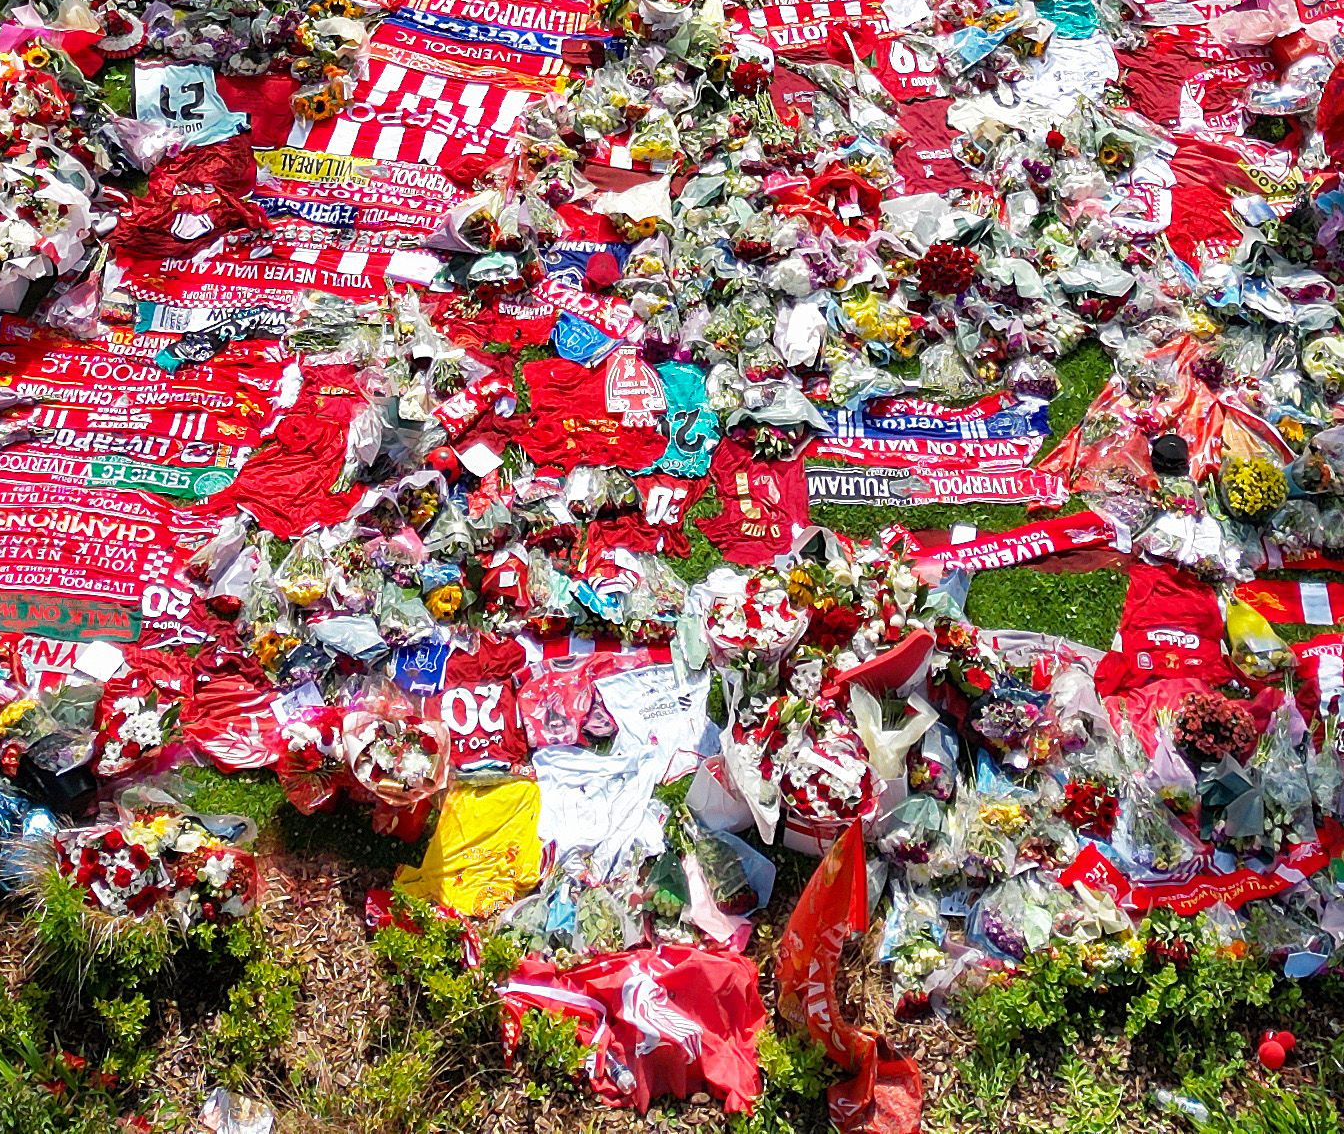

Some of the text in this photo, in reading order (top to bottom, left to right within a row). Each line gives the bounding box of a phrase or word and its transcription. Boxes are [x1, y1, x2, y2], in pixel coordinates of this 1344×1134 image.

[395, 31, 422, 46] FC
[772, 19, 828, 46] JOTA
[426, 39, 522, 64] LIVERPOOL
[159, 82, 205, 120] 21
[346, 106, 519, 155] LIVERPO
[280, 152, 355, 179] VILLAREAL
[216, 262, 259, 277] WALK
[264, 265, 323, 281] NEVER
[327, 271, 373, 290] YOU'LL
[41, 357, 71, 378] FC
[15, 382, 112, 406] CHAMPIONS
[863, 416, 960, 435] Everton
[860, 437, 918, 453] WALK
[928, 439, 957, 454] ON
[960, 440, 1018, 456] WALK
[82, 463, 94, 477] V
[101, 464, 126, 482] FC
[130, 466, 192, 487] CELTIC
[807, 475, 890, 497] FULHAM
[929, 475, 1018, 497] LIVERPOOL
[79, 543, 138, 559] WALK
[956, 530, 1050, 556] YOU'LL NEVER
[72, 555, 136, 572] YOU'LL
[944, 538, 1055, 571] LIVERPO
[57, 573, 135, 594] LIVERPOOL
[26, 602, 60, 621] ON
[141, 588, 190, 618] 20
[69, 606, 129, 627] WALK
[1146, 629, 1201, 650] Carlsberg
[1300, 644, 1344, 657] ALONE
[440, 686, 505, 735] 20
